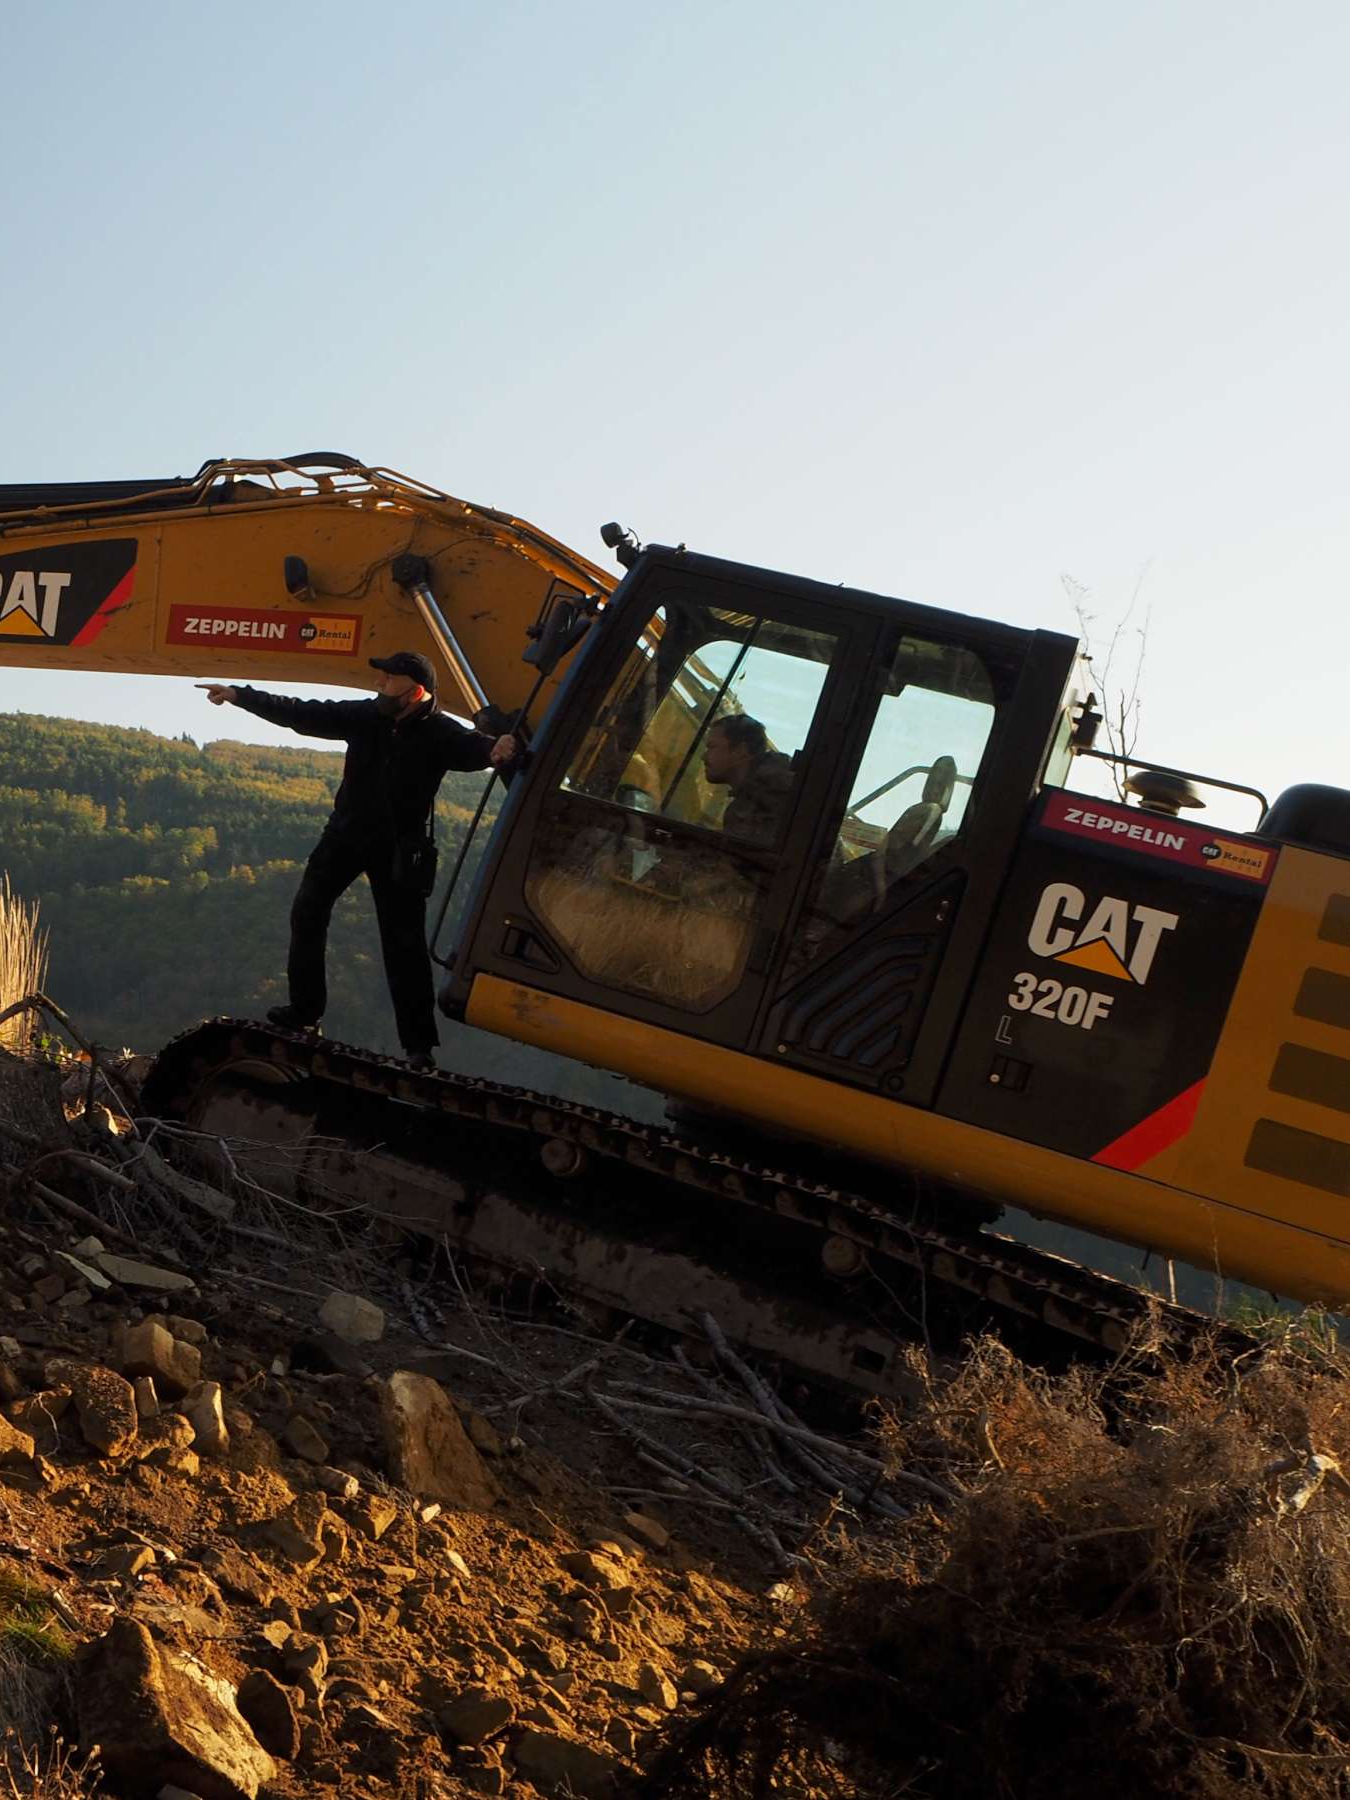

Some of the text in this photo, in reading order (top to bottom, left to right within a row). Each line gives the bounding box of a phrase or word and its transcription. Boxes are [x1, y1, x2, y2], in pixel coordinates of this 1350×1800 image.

[183, 617, 287, 640] ZEPPELIN
[301, 628, 352, 640] CAT Rental
[1063, 807, 1185, 851] ZEPPELIN
[1223, 850, 1263, 868] Rental
[1027, 882, 1180, 985] CAT
[1008, 971, 1115, 1030] 320F
